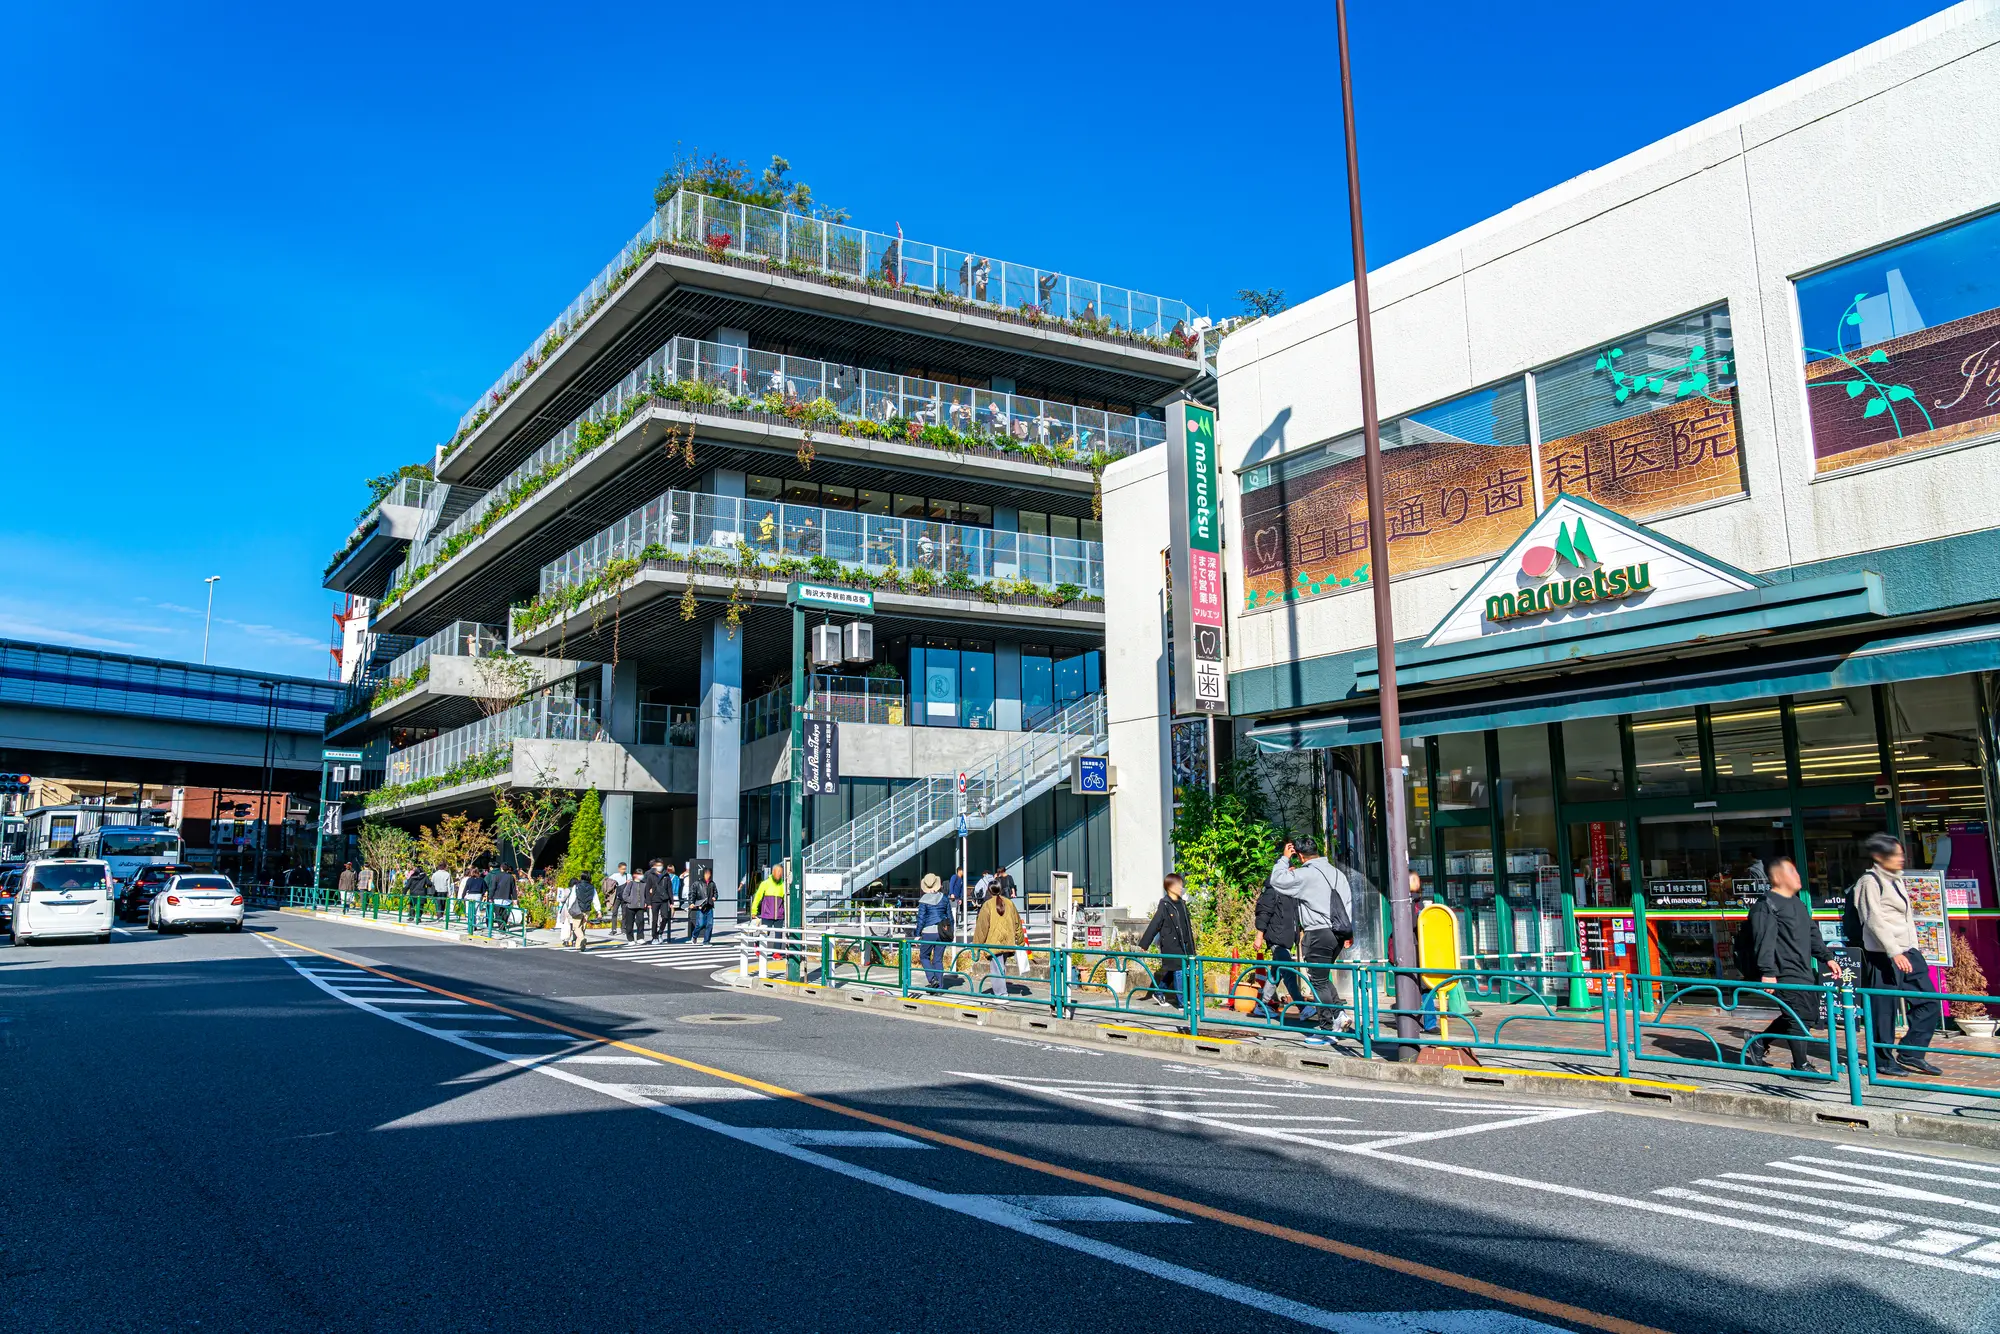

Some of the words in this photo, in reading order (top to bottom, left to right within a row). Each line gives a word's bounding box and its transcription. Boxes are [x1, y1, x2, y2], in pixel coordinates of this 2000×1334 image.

[1194, 441, 1209, 539] maruetsu
[1296, 408, 1740, 566] 自由通り歯科医院
[805, 588, 866, 604] 駒沢大学駅前商店街
[1198, 555, 1208, 605] まで営業
[1207, 556, 1218, 606] 深夜1時
[1486, 562, 1652, 622] maruetsu
[1193, 608, 1221, 620] マルエツ
[1196, 663, 1220, 698] 歯
[1204, 700, 1216, 711] 2F
[1653, 883, 1704, 893] 午前1時まで営業
[1670, 897, 1702, 905] maruetsu
